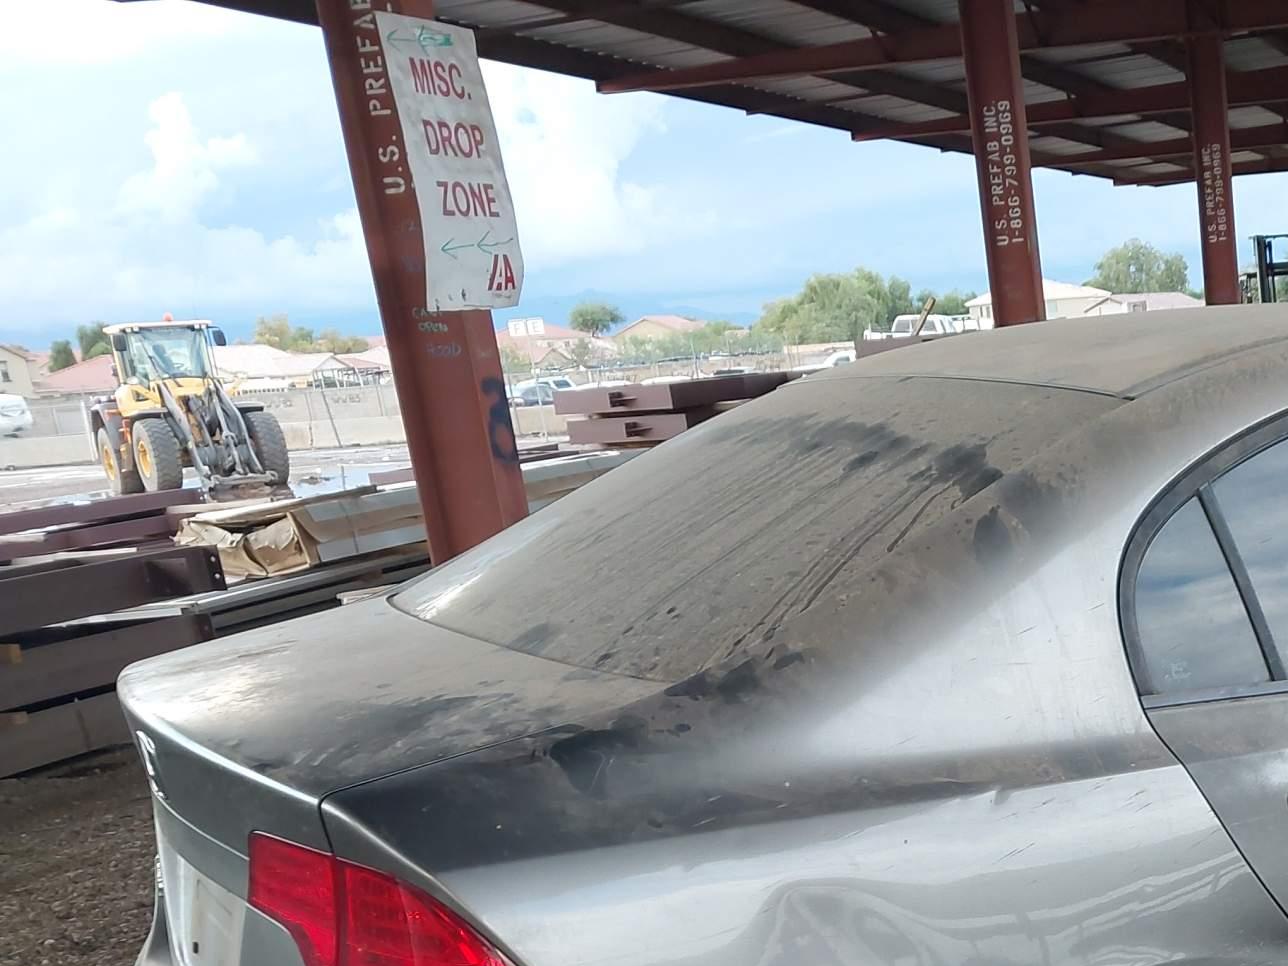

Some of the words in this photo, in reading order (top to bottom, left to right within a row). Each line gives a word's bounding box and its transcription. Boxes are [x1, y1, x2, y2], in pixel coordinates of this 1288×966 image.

[409, 56, 472, 100] MISC.
[421, 119, 484, 158] DROP
[378, 135, 406, 195] U.S.
[986, 141, 1005, 205] PREFAB
[997, 100, 1025, 243] 1-866-799-0969
[436, 181, 500, 218] ZONE
